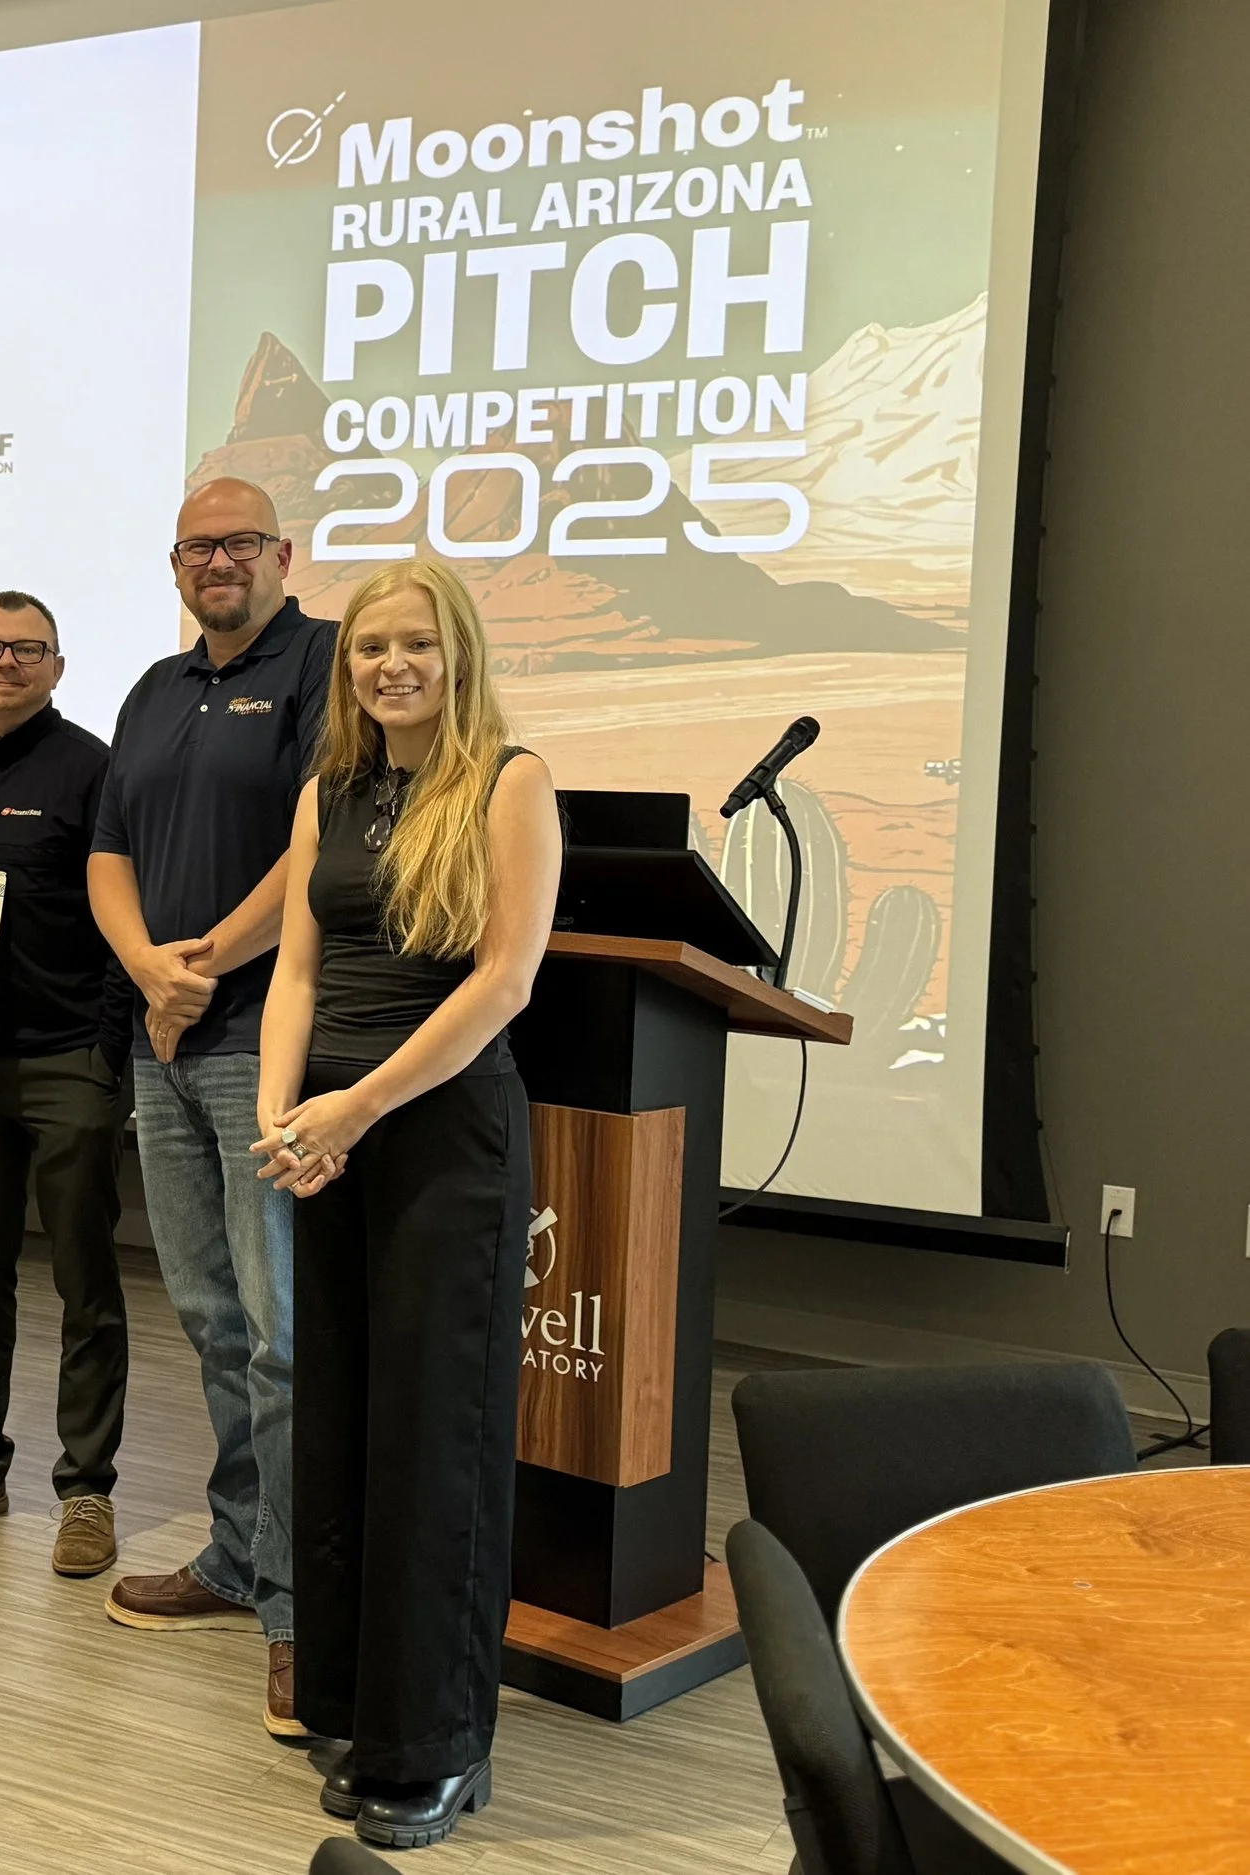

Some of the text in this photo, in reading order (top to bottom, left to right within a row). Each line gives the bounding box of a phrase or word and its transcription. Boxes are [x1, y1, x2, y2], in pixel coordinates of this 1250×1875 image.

[338, 78, 804, 188] Moonshot
[331, 158, 812, 250] RURAL ARIZONA
[323, 220, 810, 382] PITCH
[323, 372, 808, 453] COMPETITION
[311, 439, 810, 561] 2025
[522, 1348, 603, 1382] ATORY
